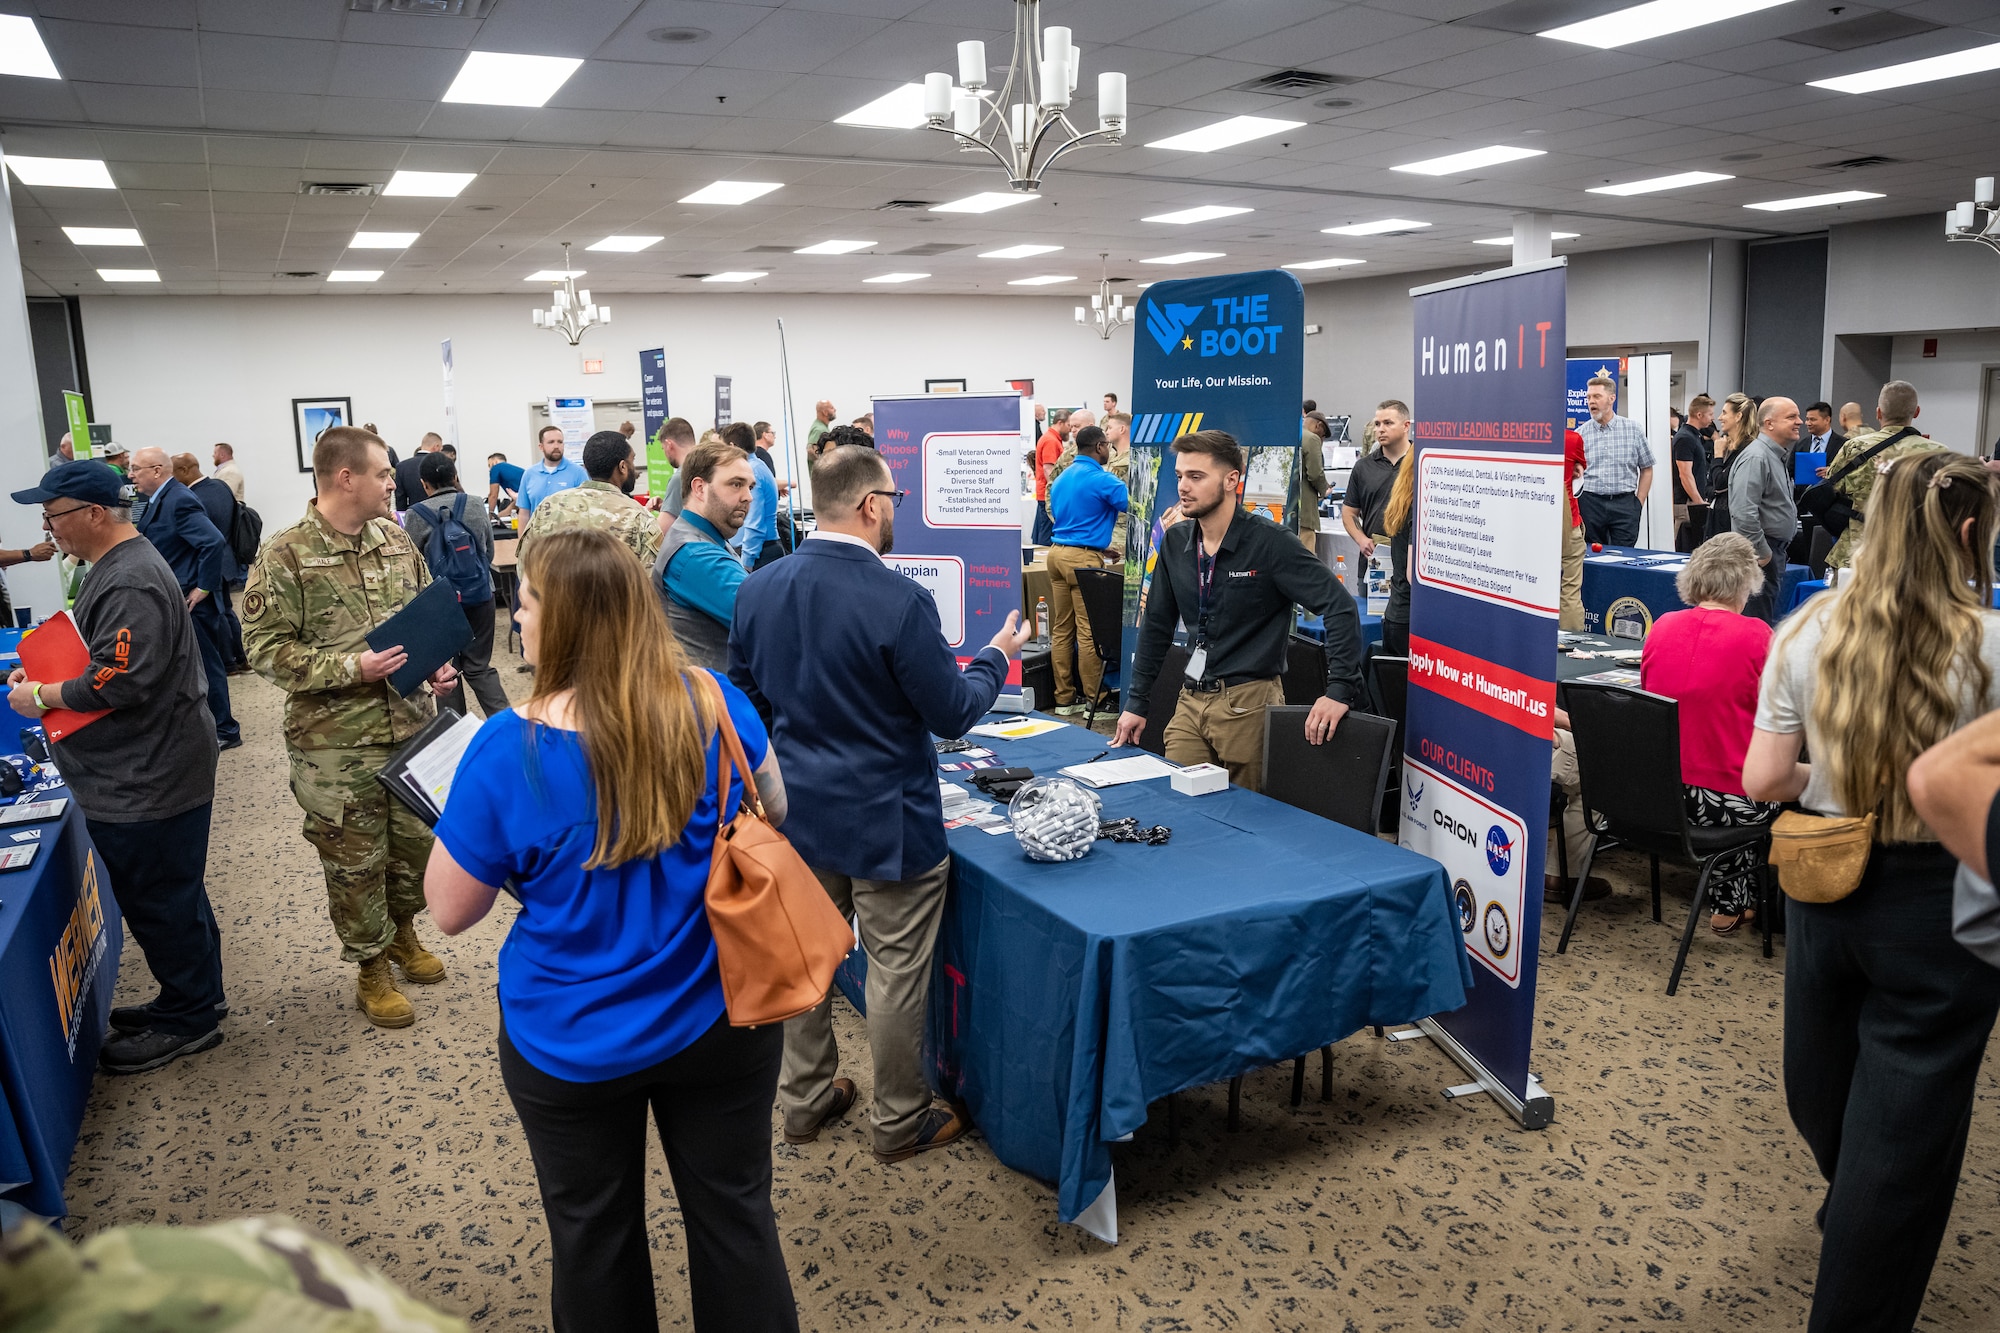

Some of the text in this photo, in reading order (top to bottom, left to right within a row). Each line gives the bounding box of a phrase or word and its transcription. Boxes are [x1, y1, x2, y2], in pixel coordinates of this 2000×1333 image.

[1212, 294, 1269, 325] THE
[1200, 325, 1283, 357] BOOT
[1155, 374, 1271, 389] Your Life, Our Mission.
[1567, 389, 1588, 398] Explo
[887, 429, 910, 441] Why
[1416, 422, 1553, 440] INDUSTRY LEADING BENEFITS
[879, 443, 919, 455] Choose
[986, 448, 1011, 456] Owned
[888, 459, 909, 470] Us?
[943, 468, 988, 476] -Experienced
[1431, 466, 1443, 475] 100%
[1444, 467, 1454, 476] Paid
[1455, 468, 1475, 480] Medical,
[1476, 469, 1494, 482] Dental,
[1500, 471, 1516, 482] Vision
[1518, 473, 1545, 485] Premiums
[1440, 481, 1461, 494] Company
[1462, 484, 1474, 493] 401K
[1476, 485, 1509, 497] Contribution
[1515, 489, 1530, 500] Profit
[1531, 490, 1555, 505] Sharing
[965, 506, 1009, 514] Partnerships
[1434, 496, 1447, 505] Weeks
[1449, 497, 1459, 507] Paid
[1460, 498, 1471, 509] Time
[1472, 499, 1481, 509] Off
[1429, 509, 1486, 528] 10 Paid Federal Holidays
[1432, 525, 1446, 534] Weeks
[1447, 526, 1457, 536] Paid
[1458, 528, 1478, 540] Parental
[1480, 531, 1495, 543] Leave
[1432, 538, 1446, 549] Weeks
[1447, 541, 1457, 551] Paid
[1458, 543, 1476, 557] Military
[1477, 546, 1492, 558] Leave
[894, 563, 938, 578] Appian
[969, 564, 1010, 576] Industry
[1228, 569, 1257, 578] HumanIT
[1428, 551, 1538, 584] $5,000 Educational Reimbursement Per Year
[969, 577, 1011, 589] Partners
[1428, 565, 1511, 593] $50 Per Month Phone Data Stipend
[1408, 648, 1547, 717] Apply Now at HumanIT.us
[1421, 738, 1495, 792] OUR CLIENTS
[1433, 809, 1477, 848] ORION
[1487, 839, 1510, 863] NASA
[49, 847, 104, 1043] WERNER
